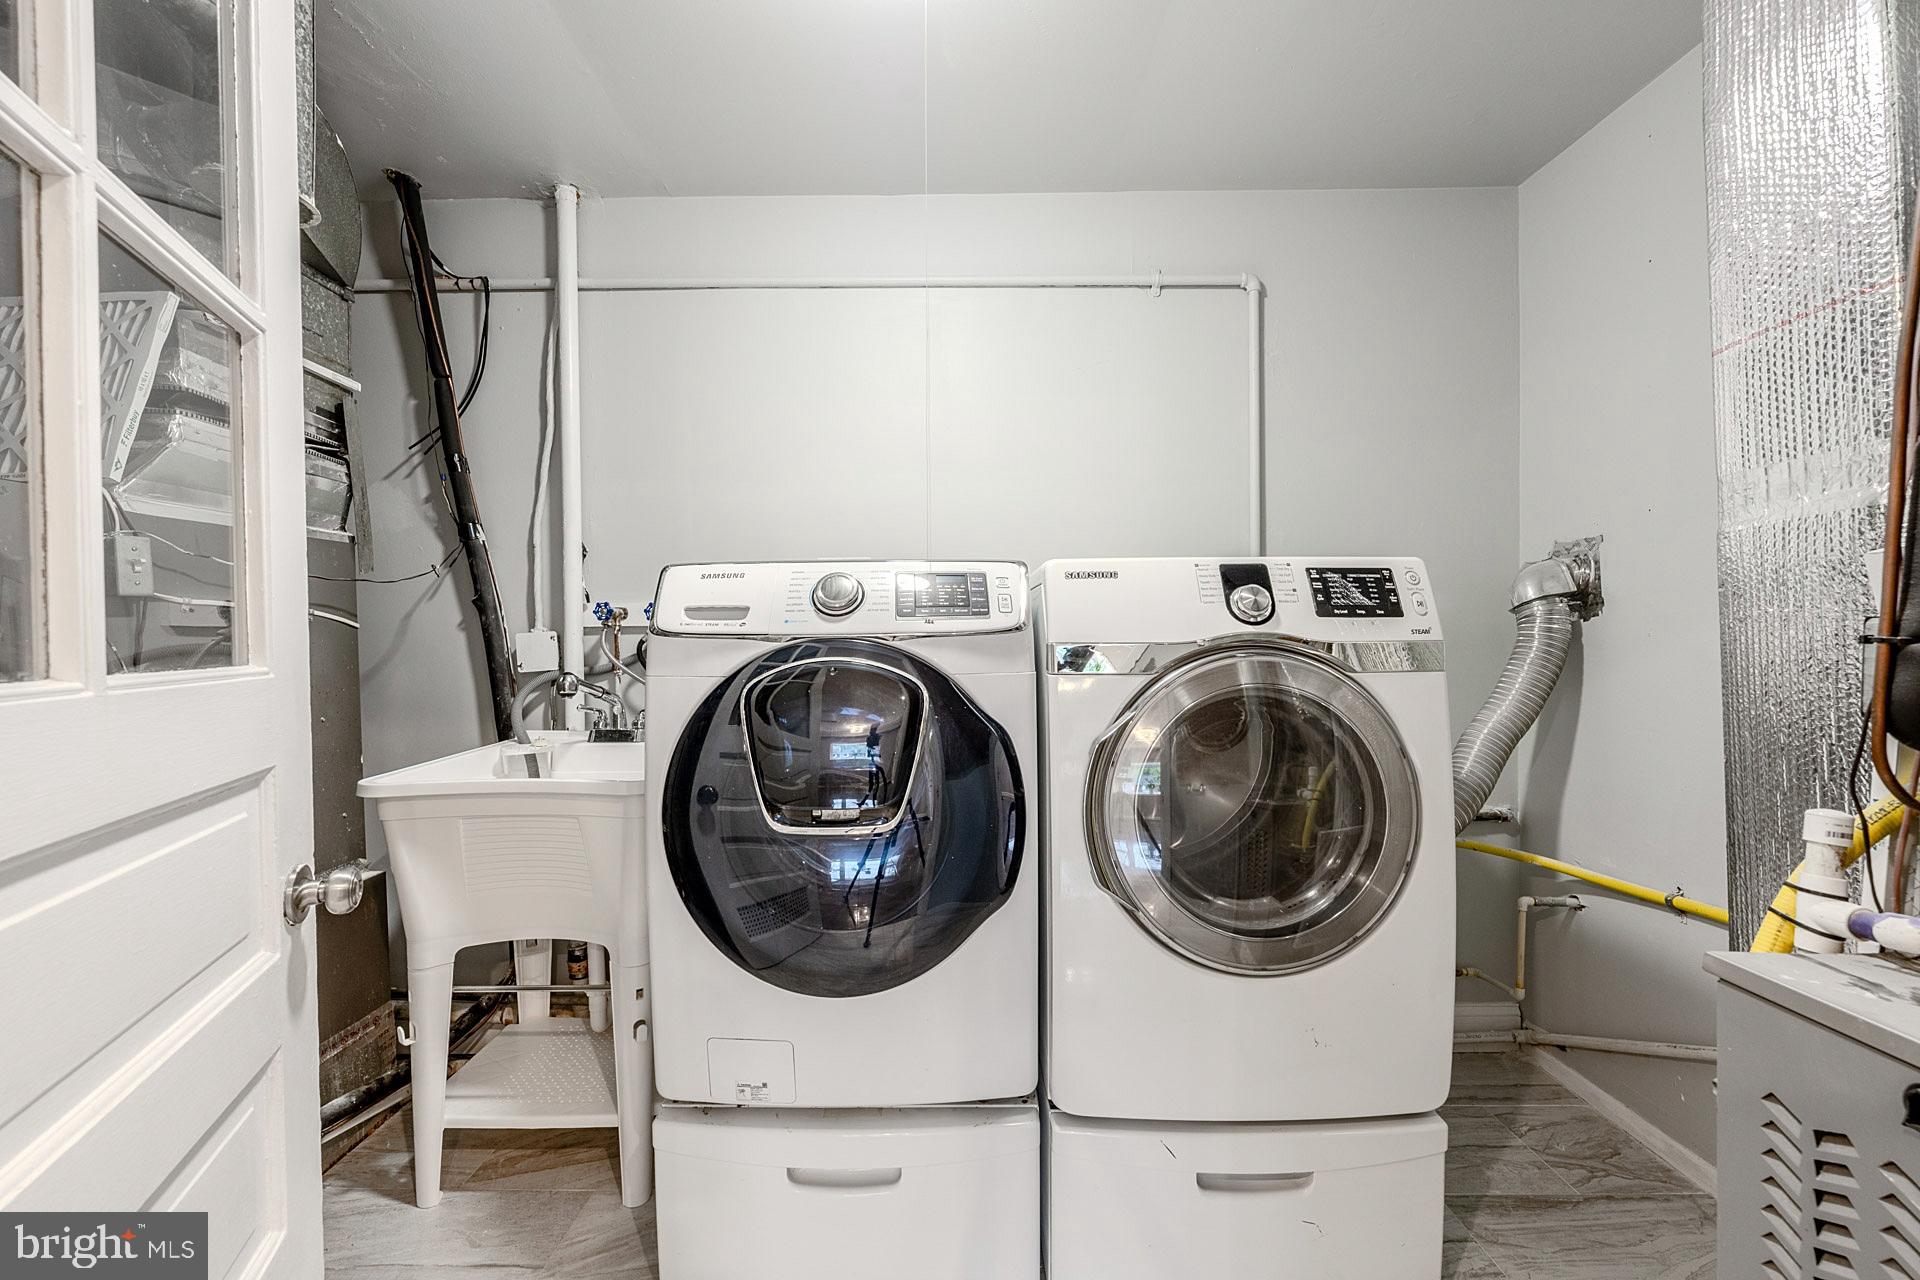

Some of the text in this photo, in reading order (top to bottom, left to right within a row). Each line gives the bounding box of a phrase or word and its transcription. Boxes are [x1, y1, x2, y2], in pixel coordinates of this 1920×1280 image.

[124, 410, 141, 441] Filterbuy
[700, 572, 746, 580] SAMSUNG
[1064, 570, 1119, 580] SAMSUNG
